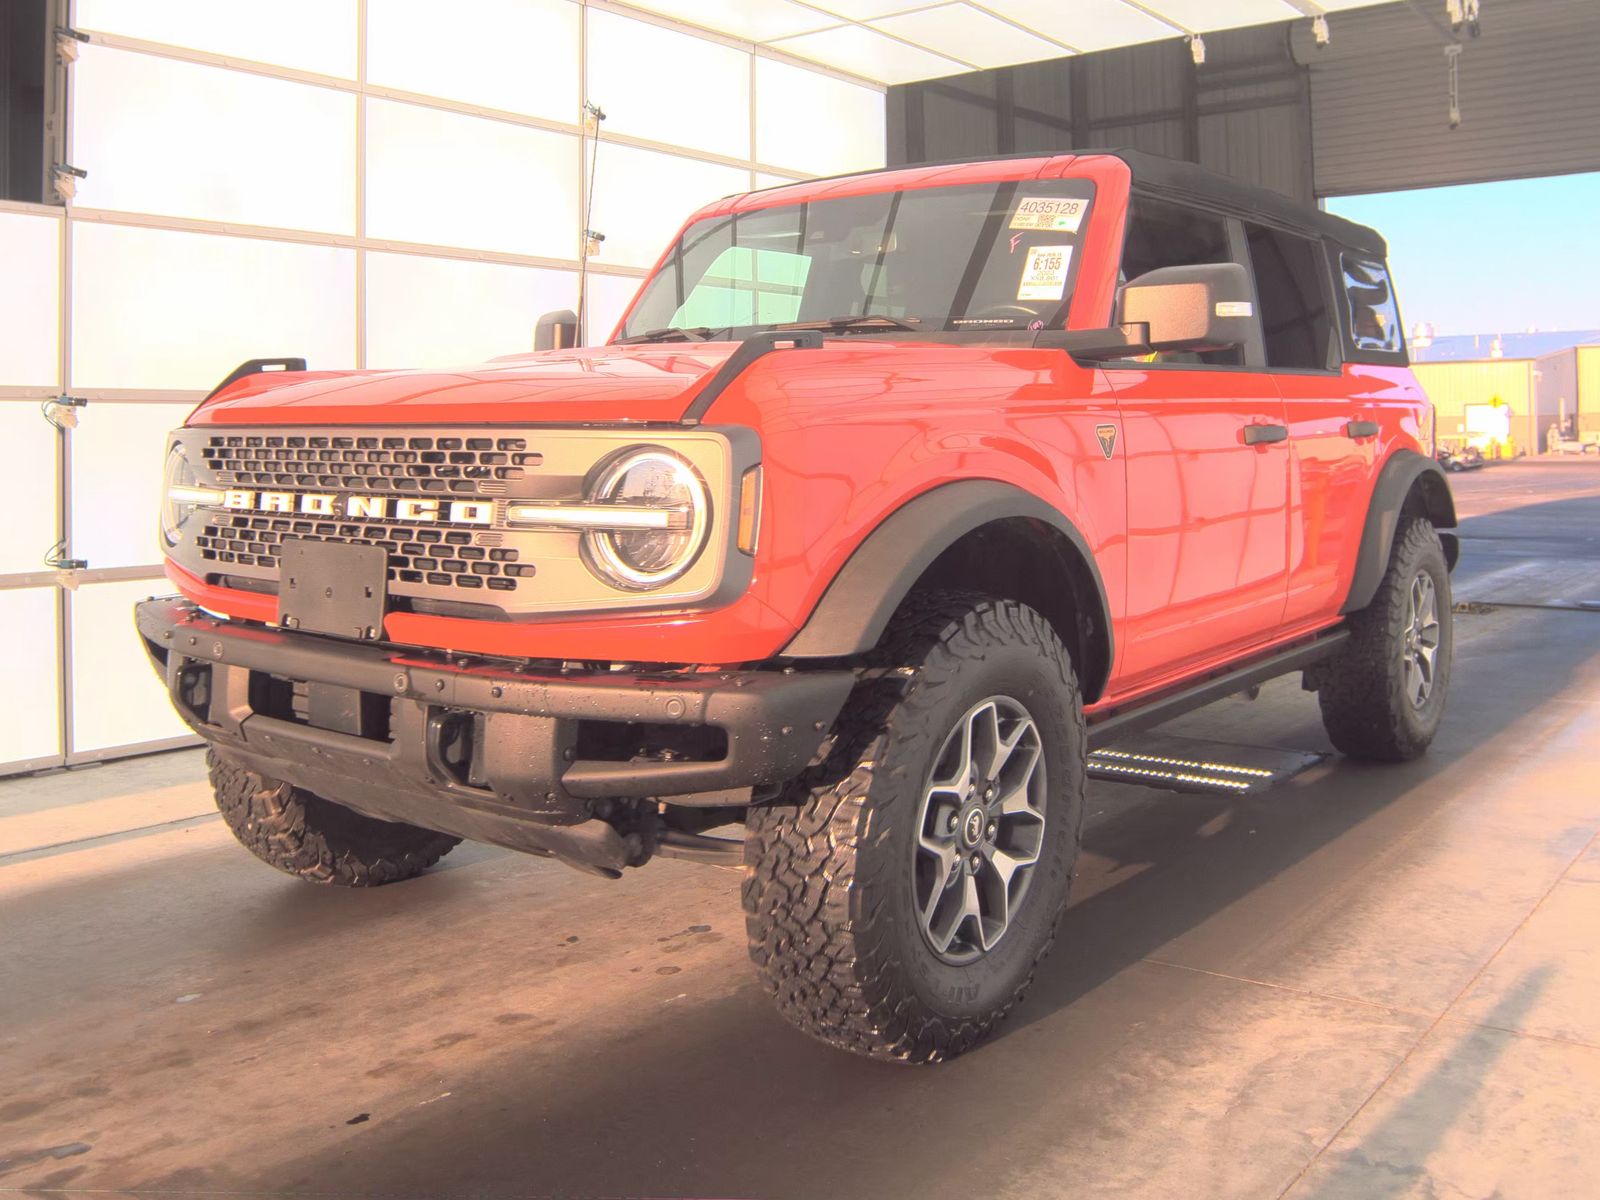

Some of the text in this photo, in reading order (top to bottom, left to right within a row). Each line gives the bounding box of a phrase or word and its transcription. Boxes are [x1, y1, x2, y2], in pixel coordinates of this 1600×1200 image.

[1020, 201, 1079, 214] 4035128
[1033, 258, 1061, 270] 6:155
[223, 490, 493, 524] BRONCO
